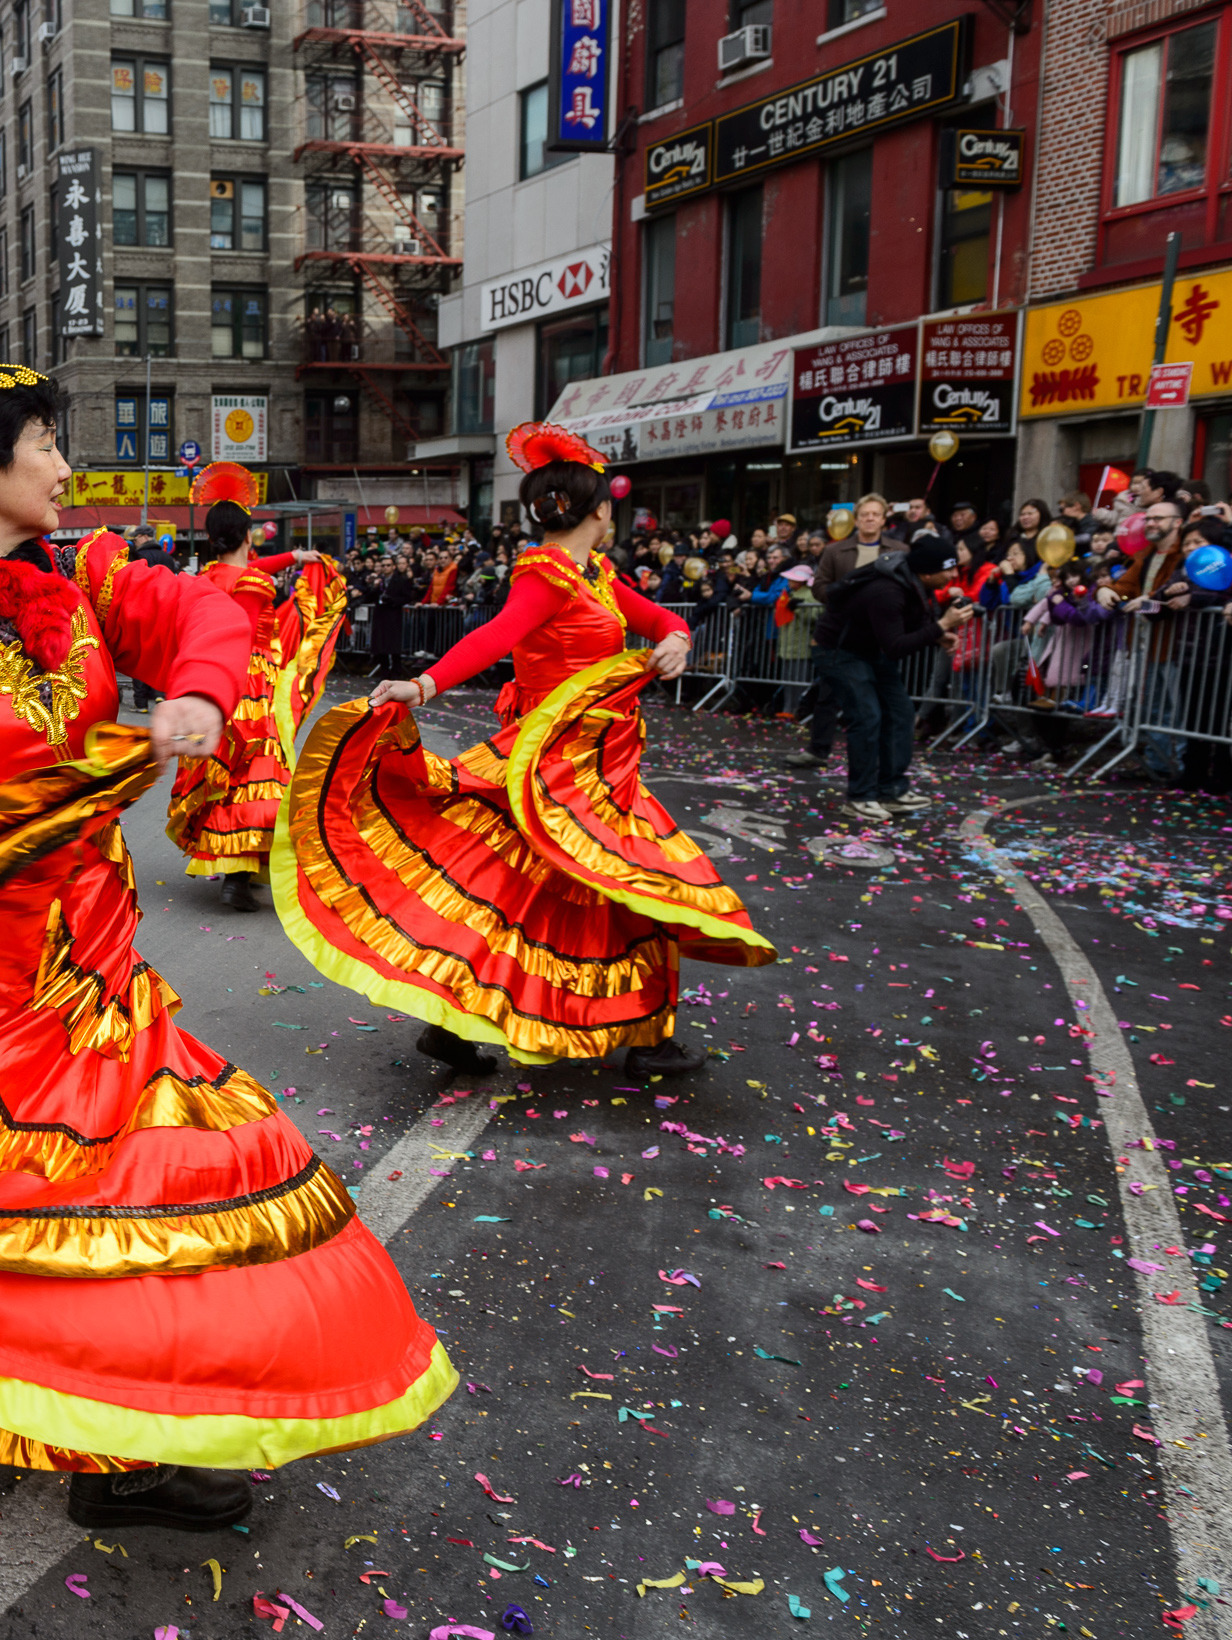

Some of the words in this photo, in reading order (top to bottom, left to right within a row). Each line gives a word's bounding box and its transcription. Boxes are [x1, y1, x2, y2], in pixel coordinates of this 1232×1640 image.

[760, 66, 866, 130] CENTURY
[872, 54, 898, 88] 21
[731, 73, 932, 169] 廿一世紀金利地產公司
[961, 134, 1010, 157] Century
[1002, 150, 1019, 169] 21
[490, 270, 553, 321] HSBC
[937, 324, 955, 334] LAW
[957, 324, 990, 334] OFFICES
[992, 324, 1004, 334] OF
[1174, 284, 1220, 346] 寺
[817, 345, 836, 356] LAW
[839, 337, 875, 353] OFFICES
[877, 334, 890, 344] OF
[819, 396, 873, 422] Century
[863, 404, 881, 430] 21
[933, 384, 990, 409] Century
[982, 399, 999, 421] 21
[86, 497, 119, 505] NUMBER
[124, 497, 140, 505] ONE
